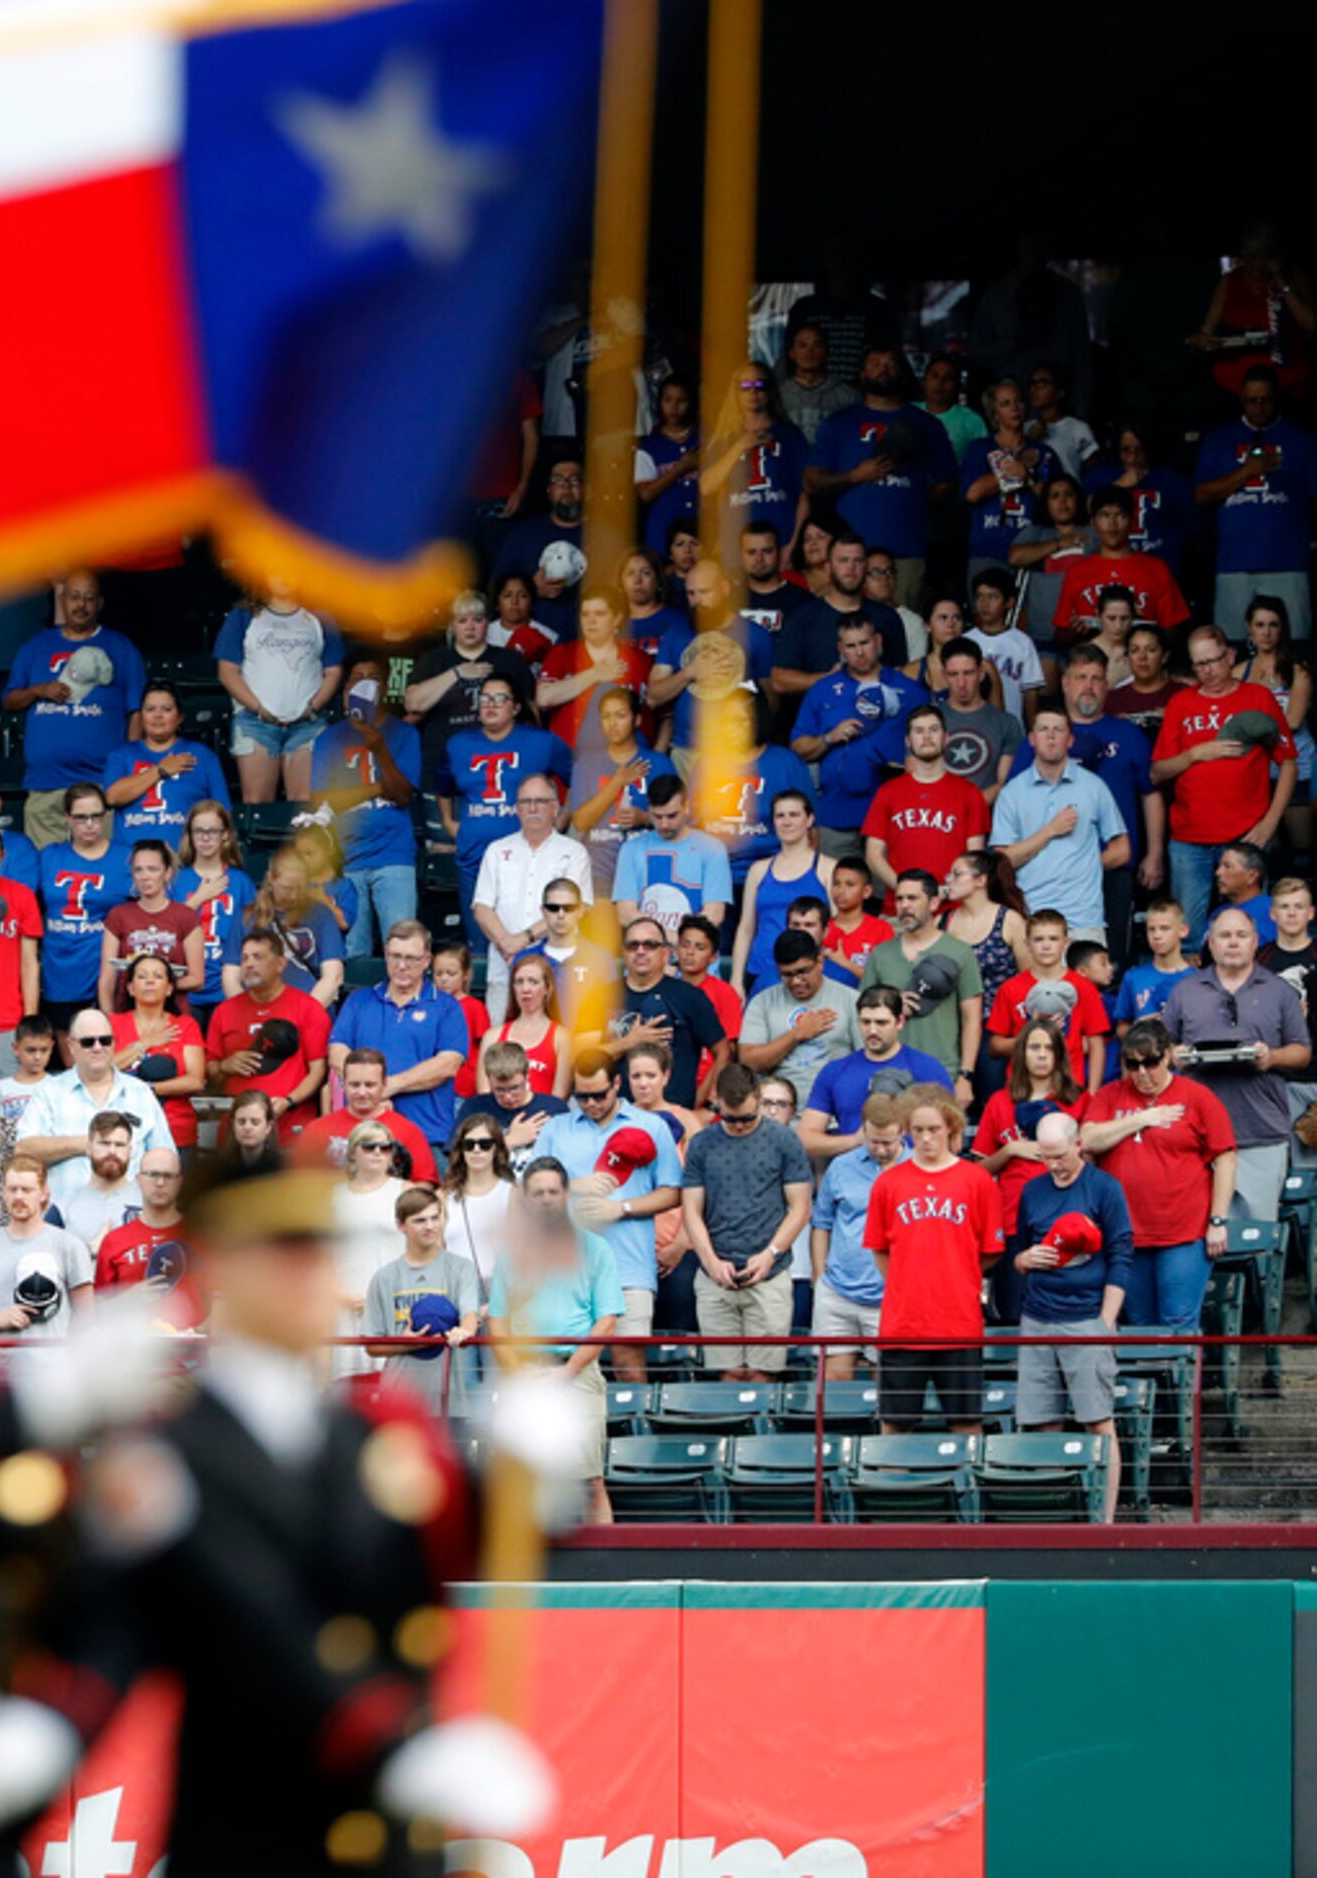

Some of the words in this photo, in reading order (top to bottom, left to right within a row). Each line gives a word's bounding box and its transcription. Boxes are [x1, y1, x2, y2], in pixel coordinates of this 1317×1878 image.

[470, 751, 519, 802] T
[892, 808, 957, 833] TEXAS
[55, 870, 104, 921] T
[896, 1196, 968, 1225] TEXAS
